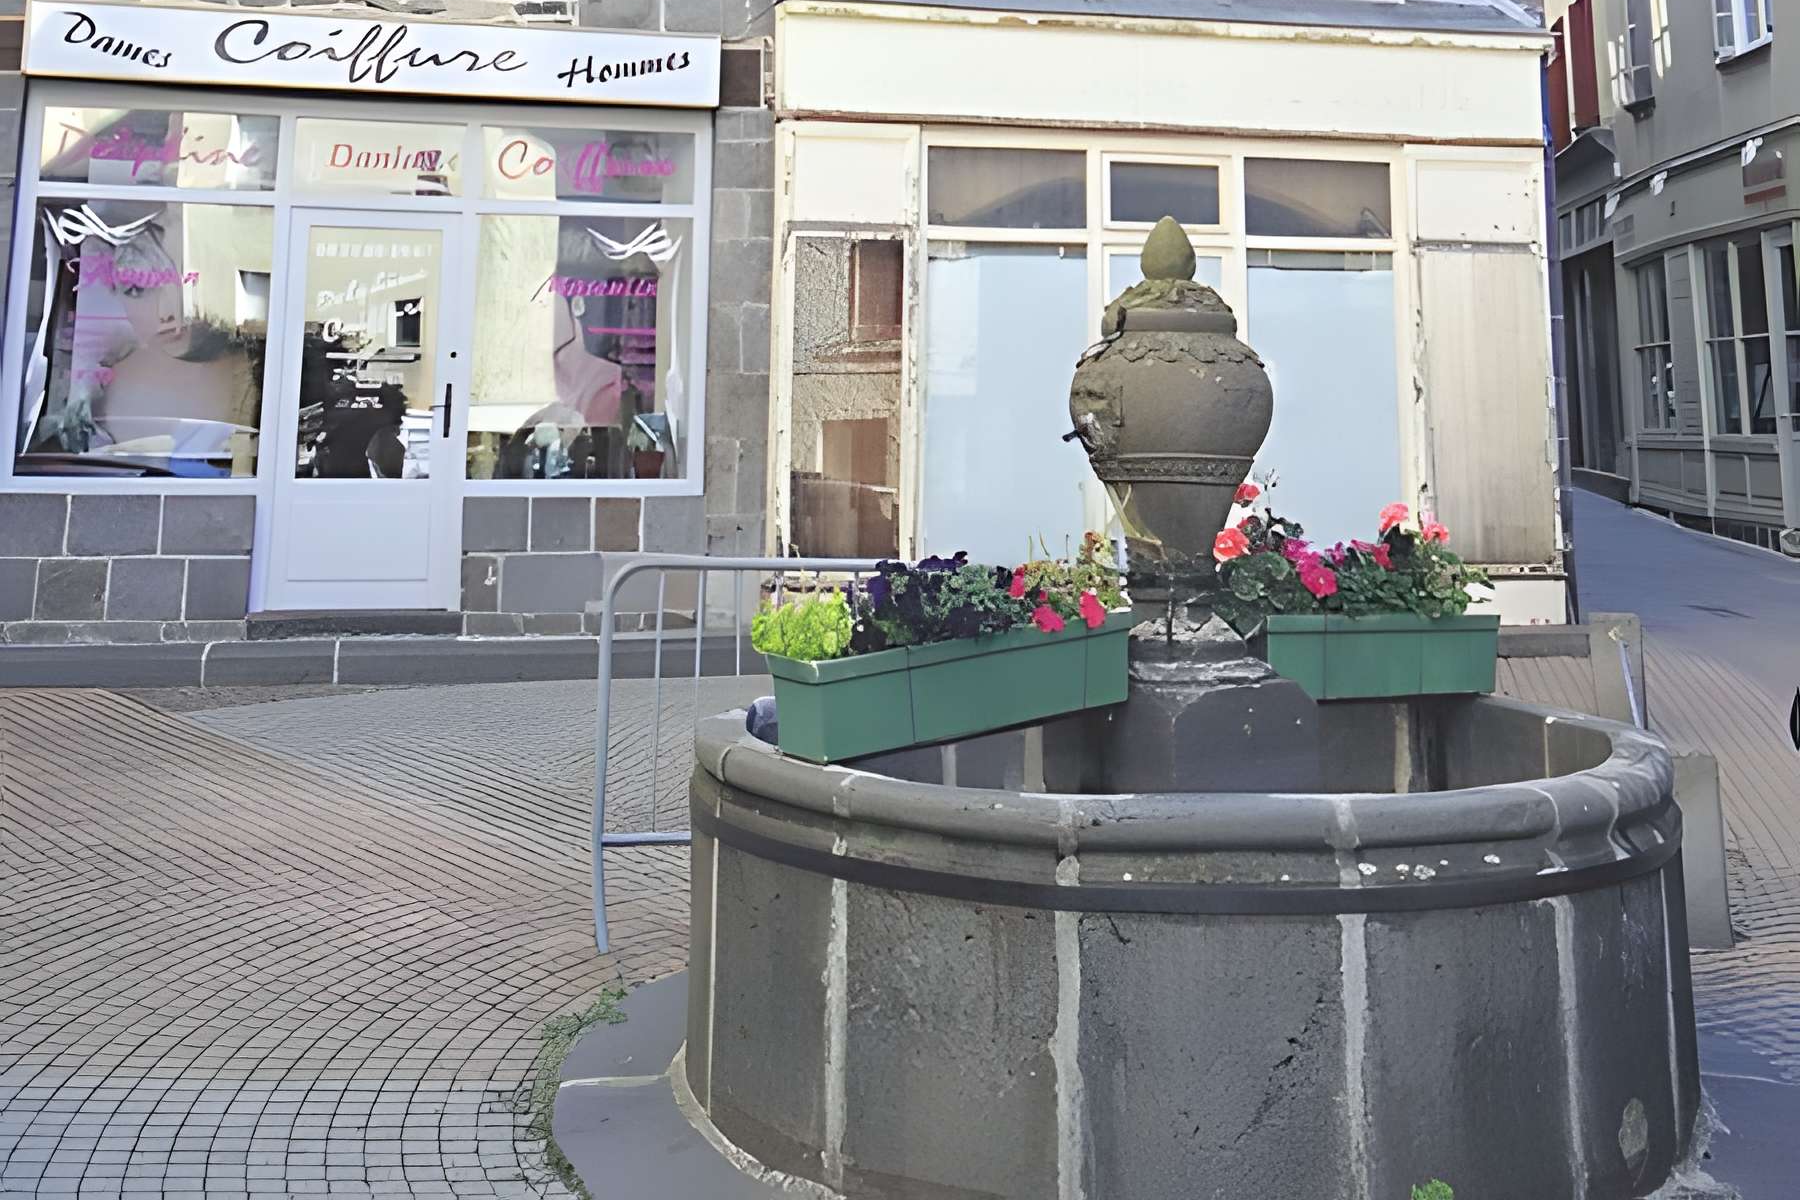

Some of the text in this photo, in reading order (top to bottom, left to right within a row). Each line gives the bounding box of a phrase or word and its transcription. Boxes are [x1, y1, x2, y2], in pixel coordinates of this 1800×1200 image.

[61, 11, 690, 88] Dames Coiffure Hommes
